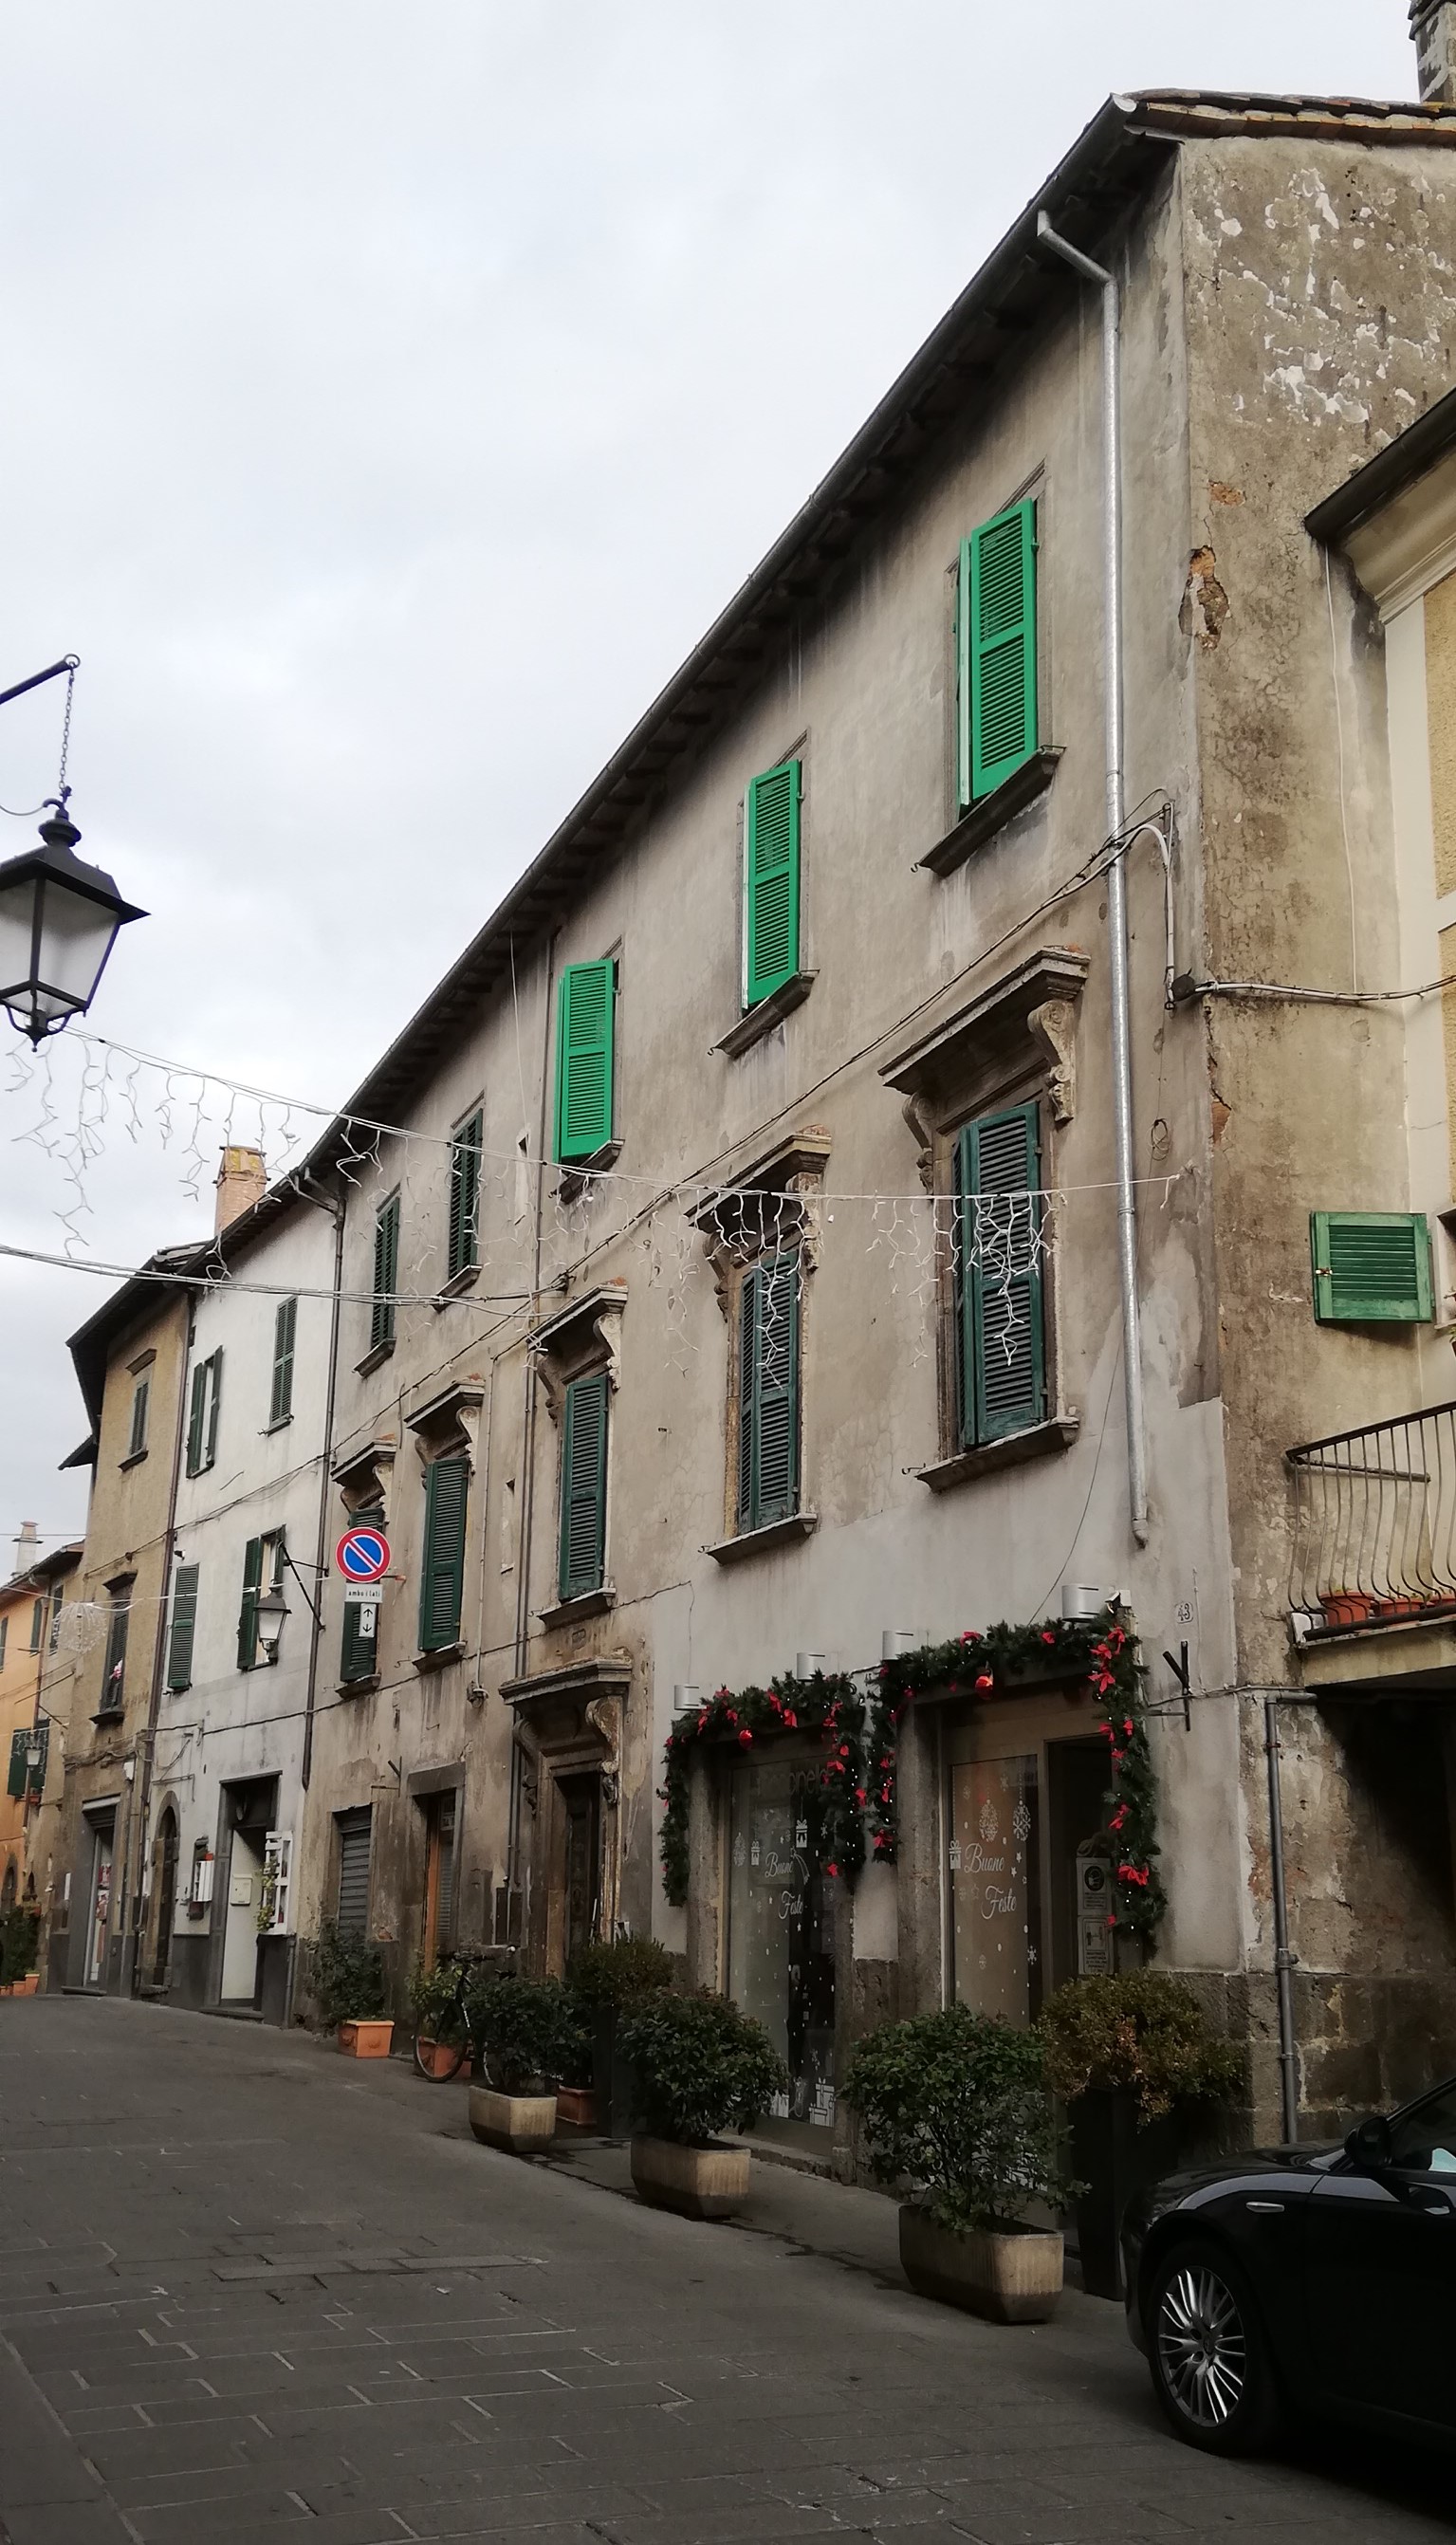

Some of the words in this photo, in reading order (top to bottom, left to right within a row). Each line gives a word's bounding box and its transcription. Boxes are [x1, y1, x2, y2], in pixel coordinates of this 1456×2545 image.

[1178, 1603, 1190, 1621] 43
[765, 1852, 794, 1878] Buone
[964, 1842, 1004, 1873] Buone
[778, 1890, 803, 1920] Feste
[980, 1885, 1017, 1920] Feste
